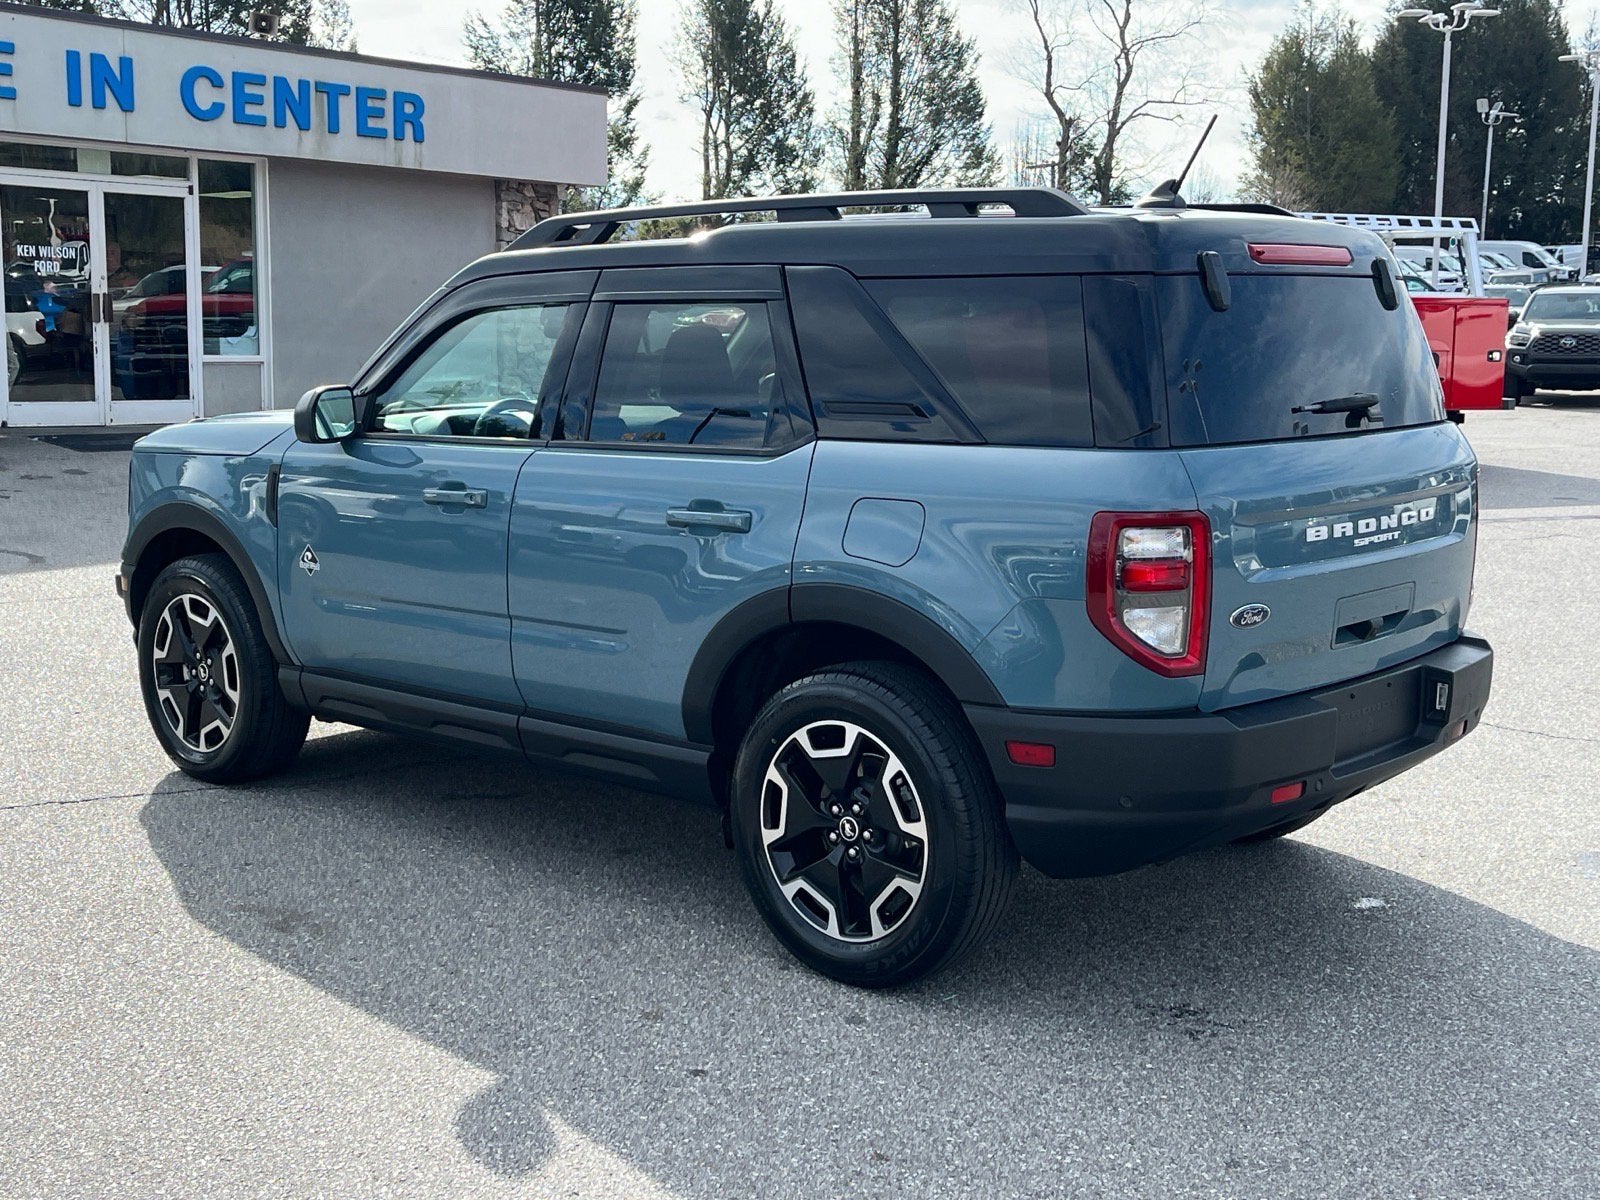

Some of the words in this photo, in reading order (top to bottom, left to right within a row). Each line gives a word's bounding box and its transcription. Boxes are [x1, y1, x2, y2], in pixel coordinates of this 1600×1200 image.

[66, 49, 135, 112] IN
[179, 65, 425, 143] CENTER
[16, 244, 36, 257] KEN
[38, 245, 76, 259] WILSON
[34, 260, 60, 273] FORD
[1306, 506, 1434, 542] BRONCO
[1353, 531, 1401, 547] SPORT
